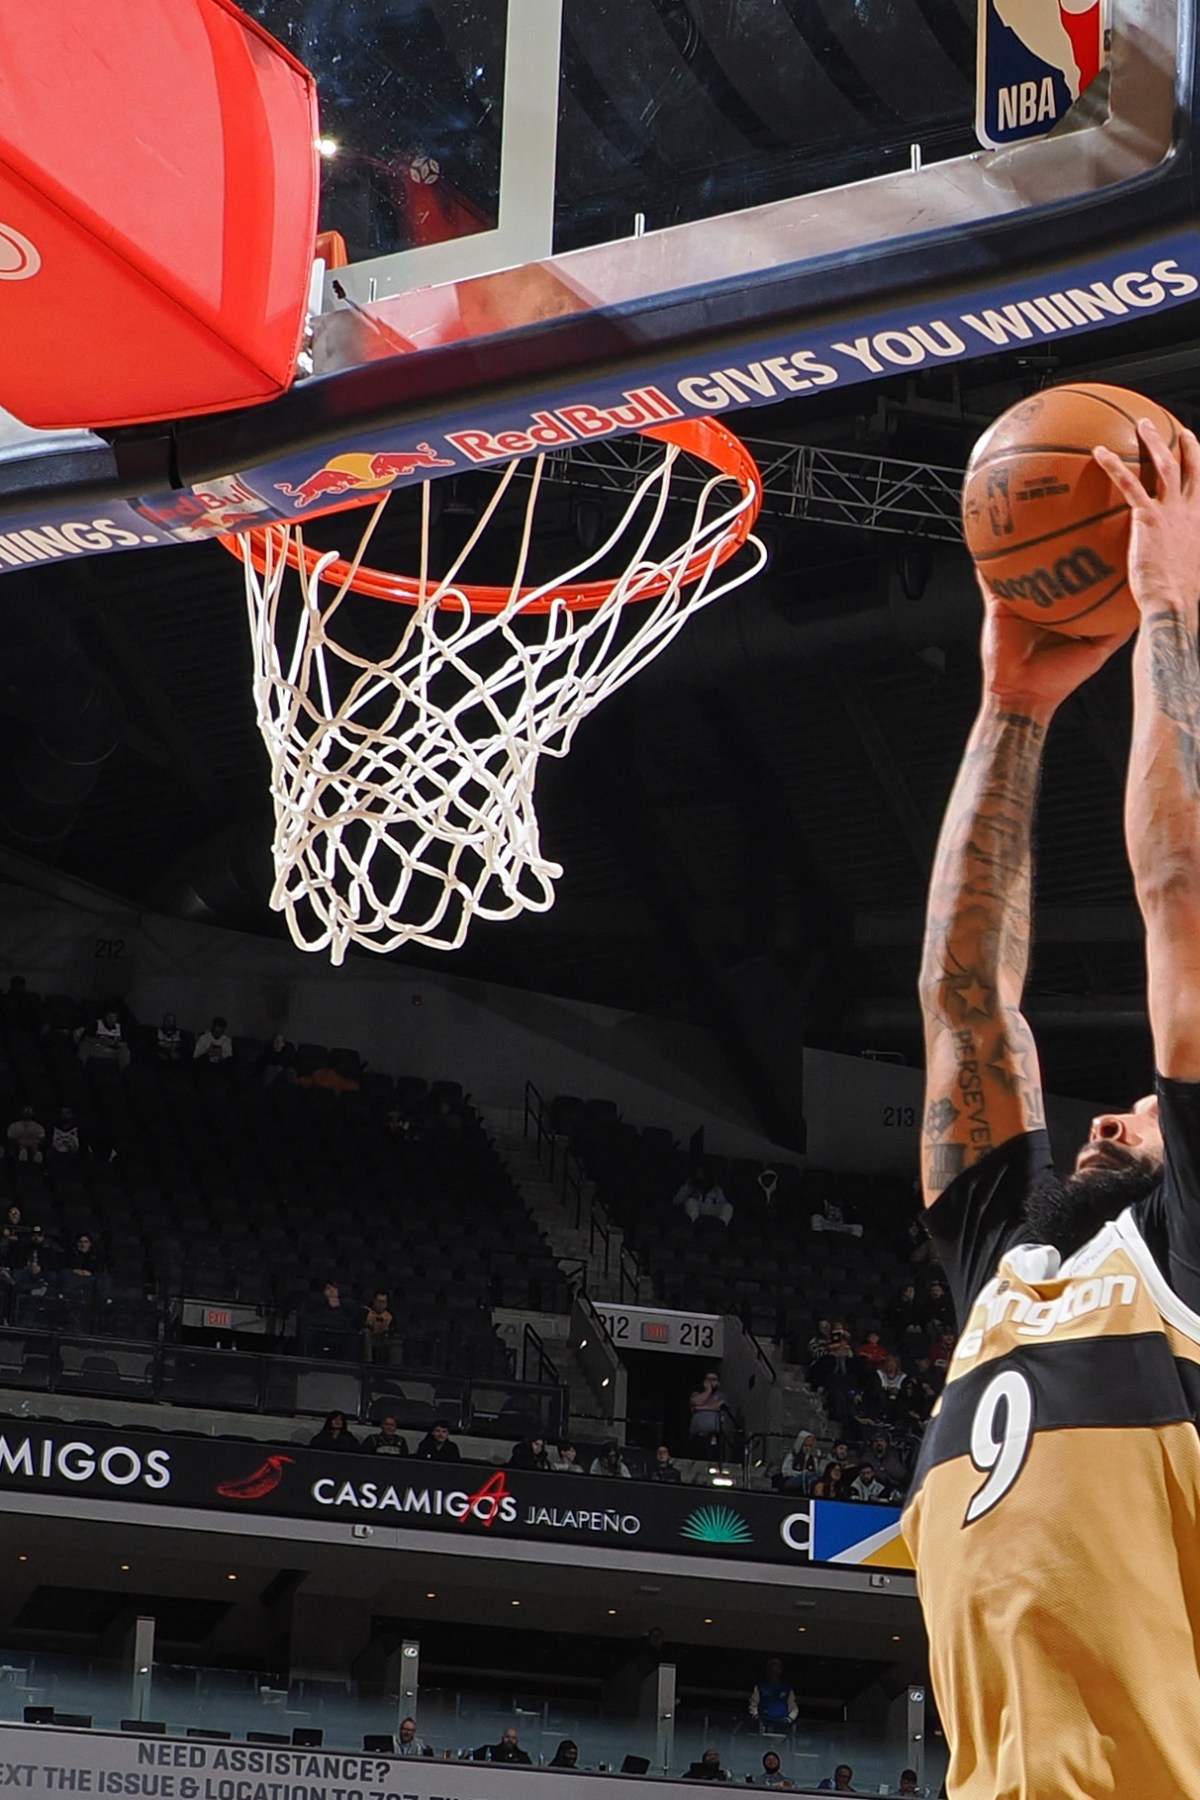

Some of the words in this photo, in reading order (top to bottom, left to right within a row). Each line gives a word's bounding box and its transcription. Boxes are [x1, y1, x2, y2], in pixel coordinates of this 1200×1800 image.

[997, 77, 1056, 131] NBA
[444, 410, 577, 463] Red
[553, 386, 685, 438] Bull
[677, 350, 838, 410] GIVES
[831, 319, 967, 373] YOU
[199, 481, 255, 513] Bull
[0, 519, 158, 569] IIINGS.
[883, 1107, 914, 1128] 213
[680, 1323, 714, 1349] 213
[965, 1369, 1034, 1526] 9
[0, 1434, 171, 1489] MIGOS
[309, 1477, 518, 1524] CASAMIGOS
[524, 1505, 641, 1535] JALAPEÑO
[43, 1766, 92, 1791] THE
[99, 1770, 174, 1797] ISSUE
[179, 1776, 200, 1799] &
[137, 1742, 206, 1768] NEED
[212, 1748, 391, 1783] ASSISTANCE?
